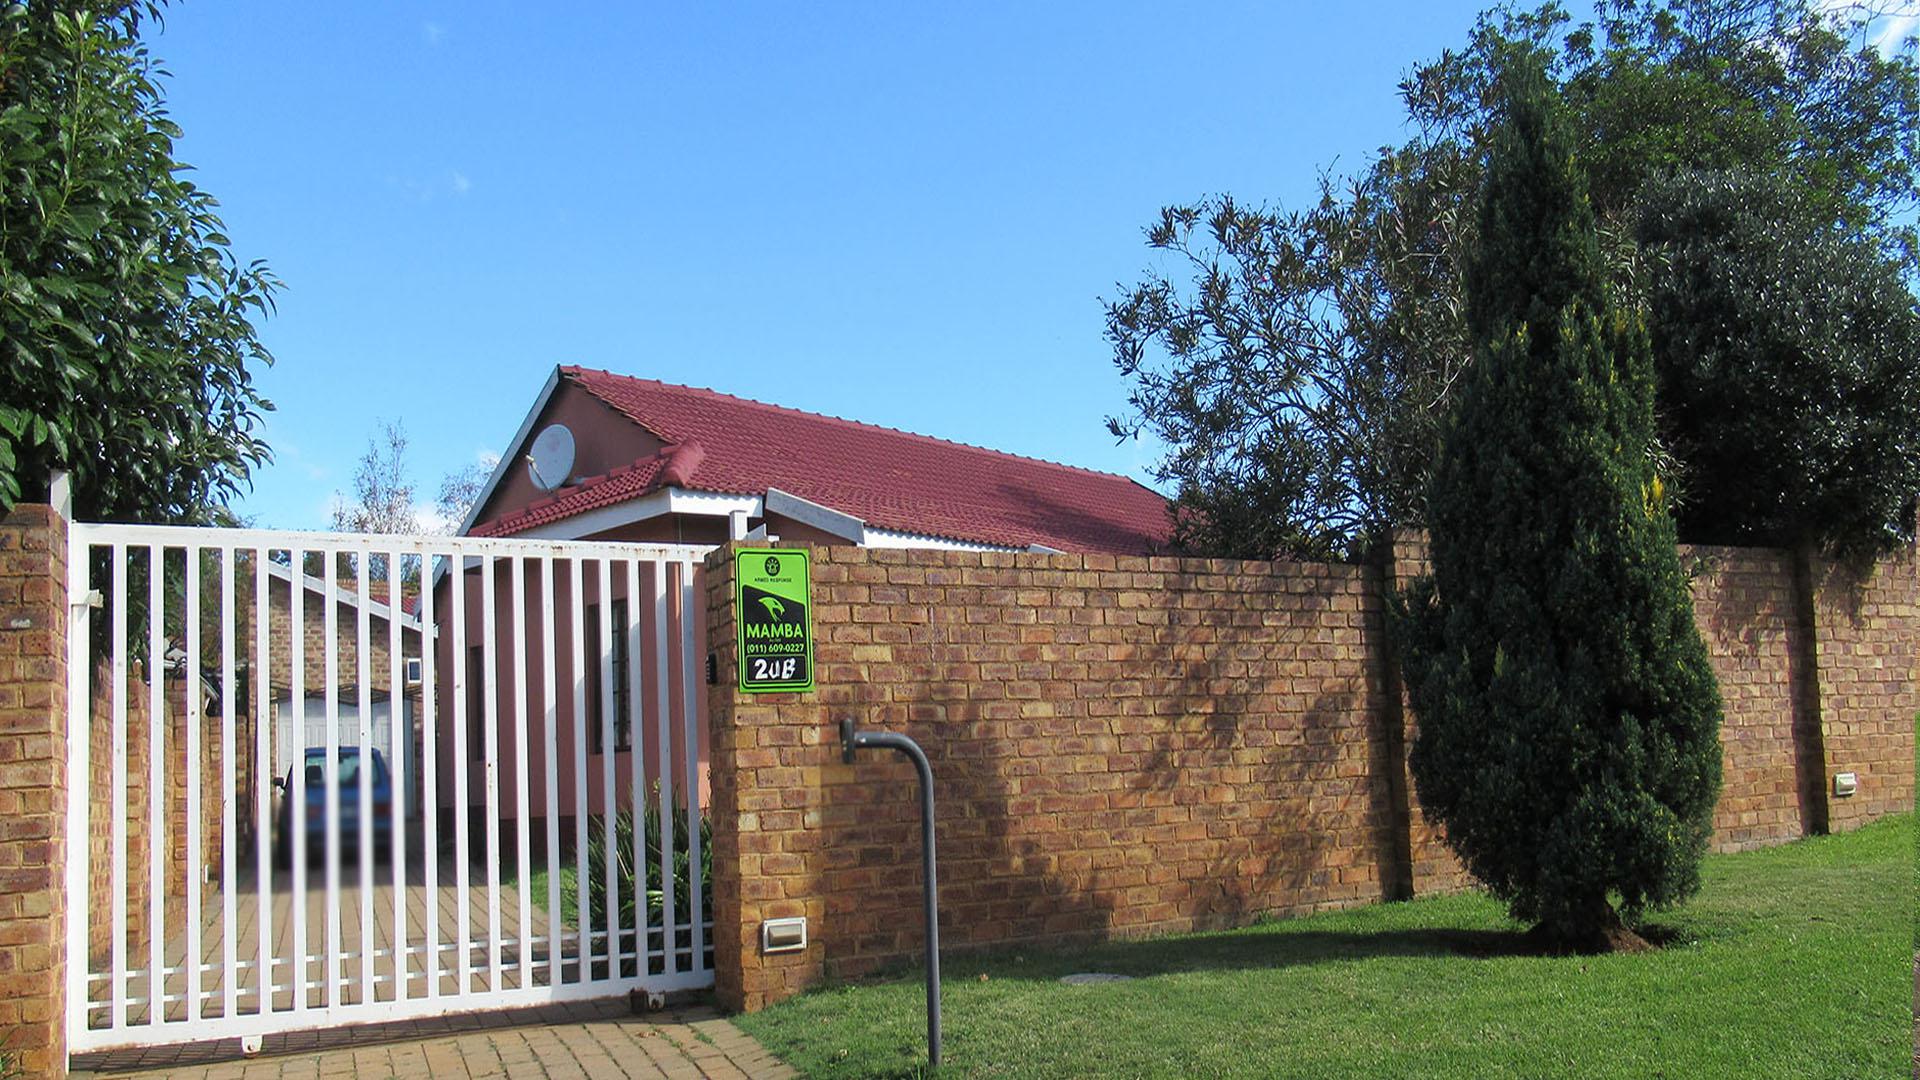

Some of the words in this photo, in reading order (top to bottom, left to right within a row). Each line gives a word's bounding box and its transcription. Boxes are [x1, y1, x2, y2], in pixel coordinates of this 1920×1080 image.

[747, 623, 803, 638] MAMBA
[747, 644, 767, 654] (011)
[768, 643, 804, 653] 609-0227
